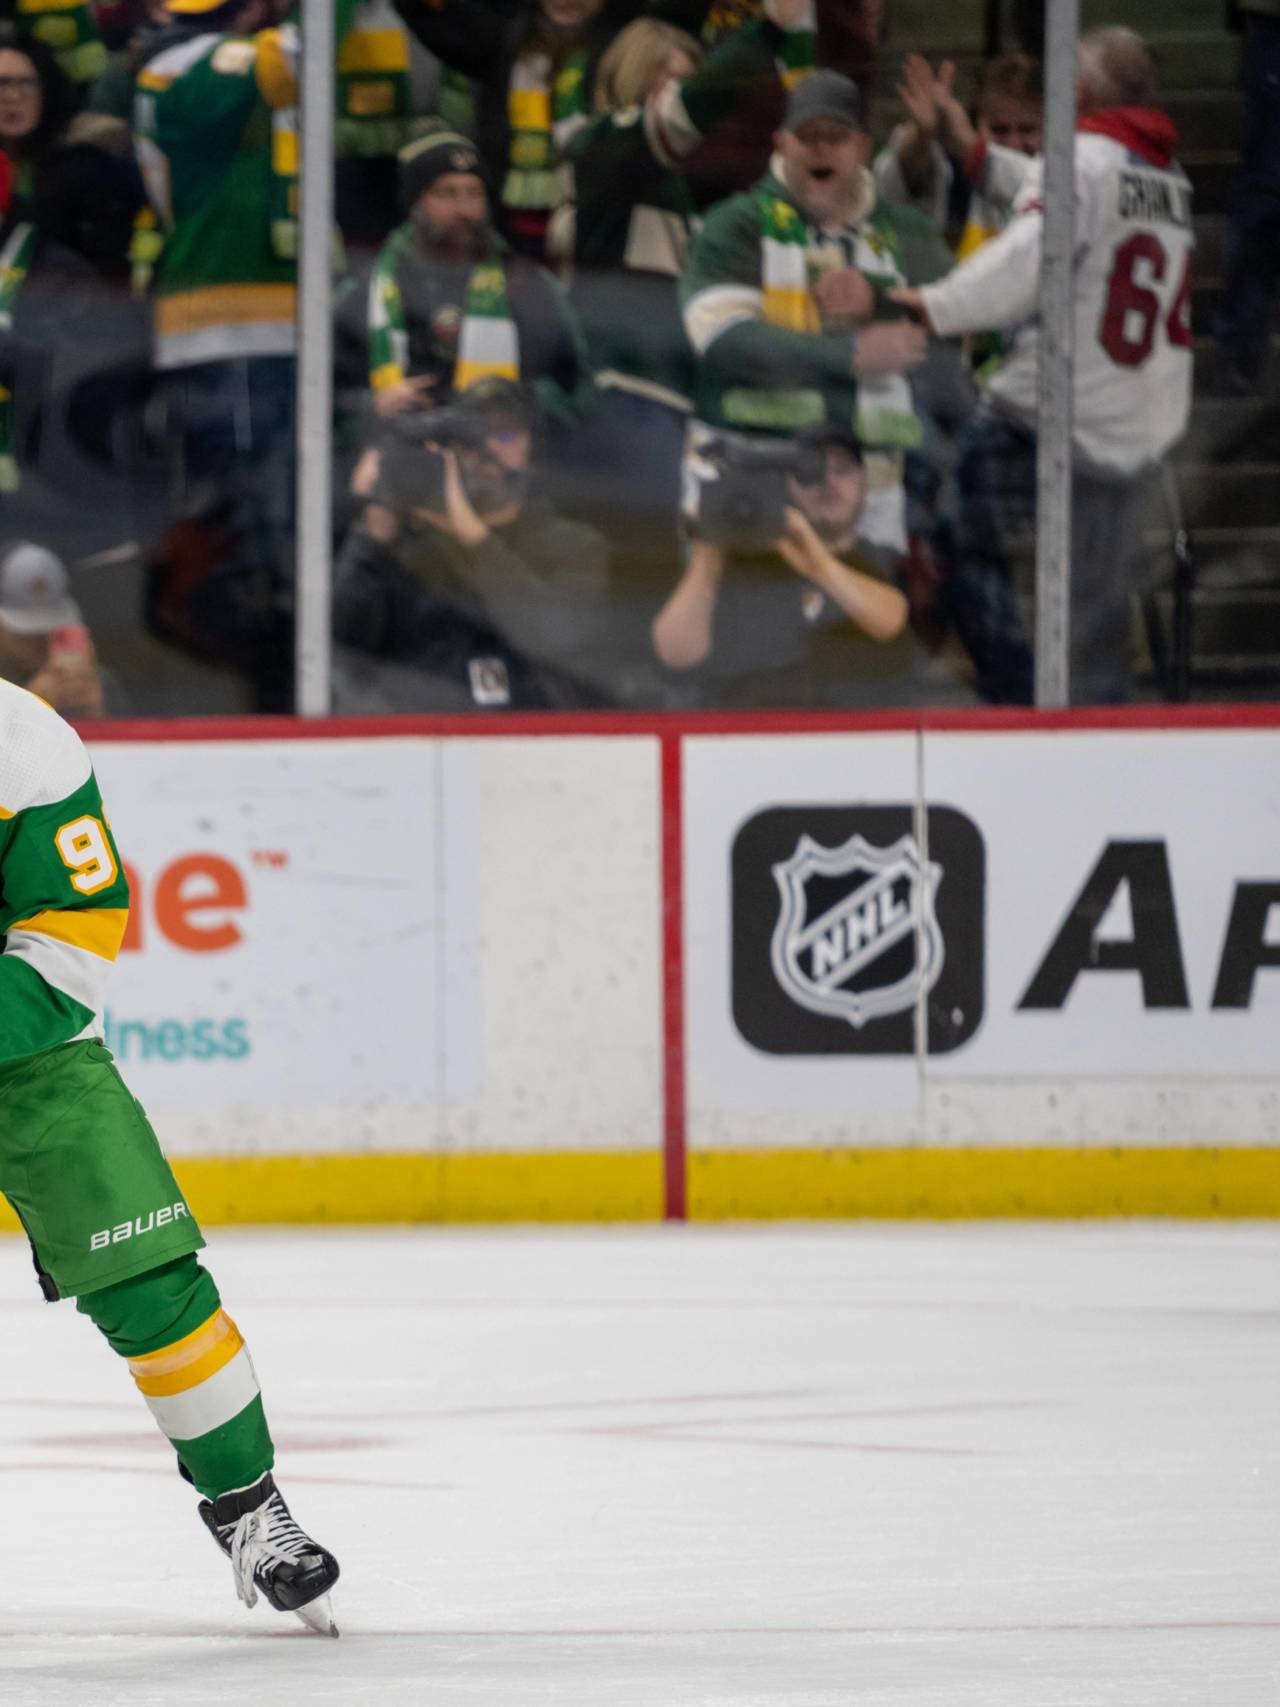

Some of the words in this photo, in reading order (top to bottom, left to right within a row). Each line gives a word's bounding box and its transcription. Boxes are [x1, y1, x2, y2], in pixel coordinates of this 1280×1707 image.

[54, 813, 120, 897] 9
[811, 883, 910, 978] NHL
[89, 1201, 190, 1253] BAUER
